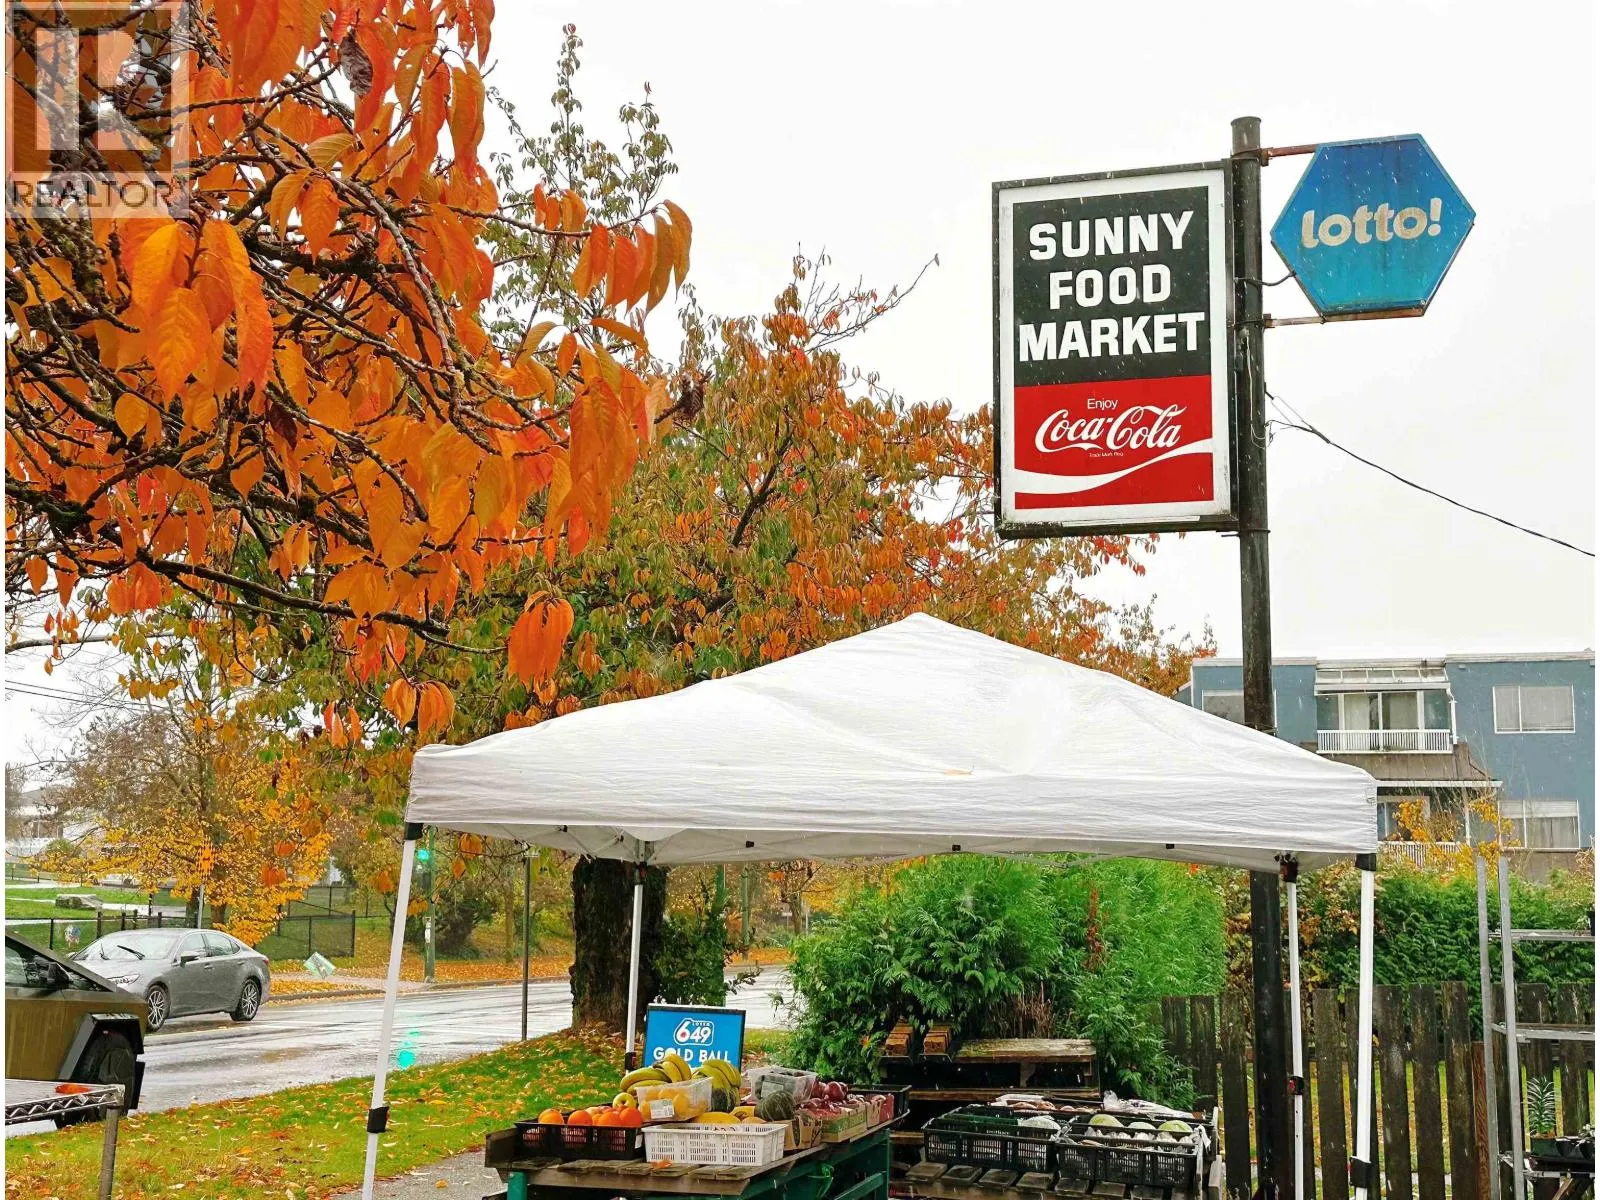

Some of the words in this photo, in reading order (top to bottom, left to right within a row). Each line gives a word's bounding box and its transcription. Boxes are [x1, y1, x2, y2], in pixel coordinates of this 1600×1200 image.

[1029, 210, 1194, 261] SUNNY
[1301, 197, 1442, 248] lotto!
[1049, 263, 1171, 310] FOOD
[1018, 312, 1205, 362] MARKET
[1034, 404, 1188, 453] Coca-Cola
[1087, 398, 1119, 411] Enjoy
[676, 1020, 712, 1043] 649
[698, 1049, 732, 1063] BALL
